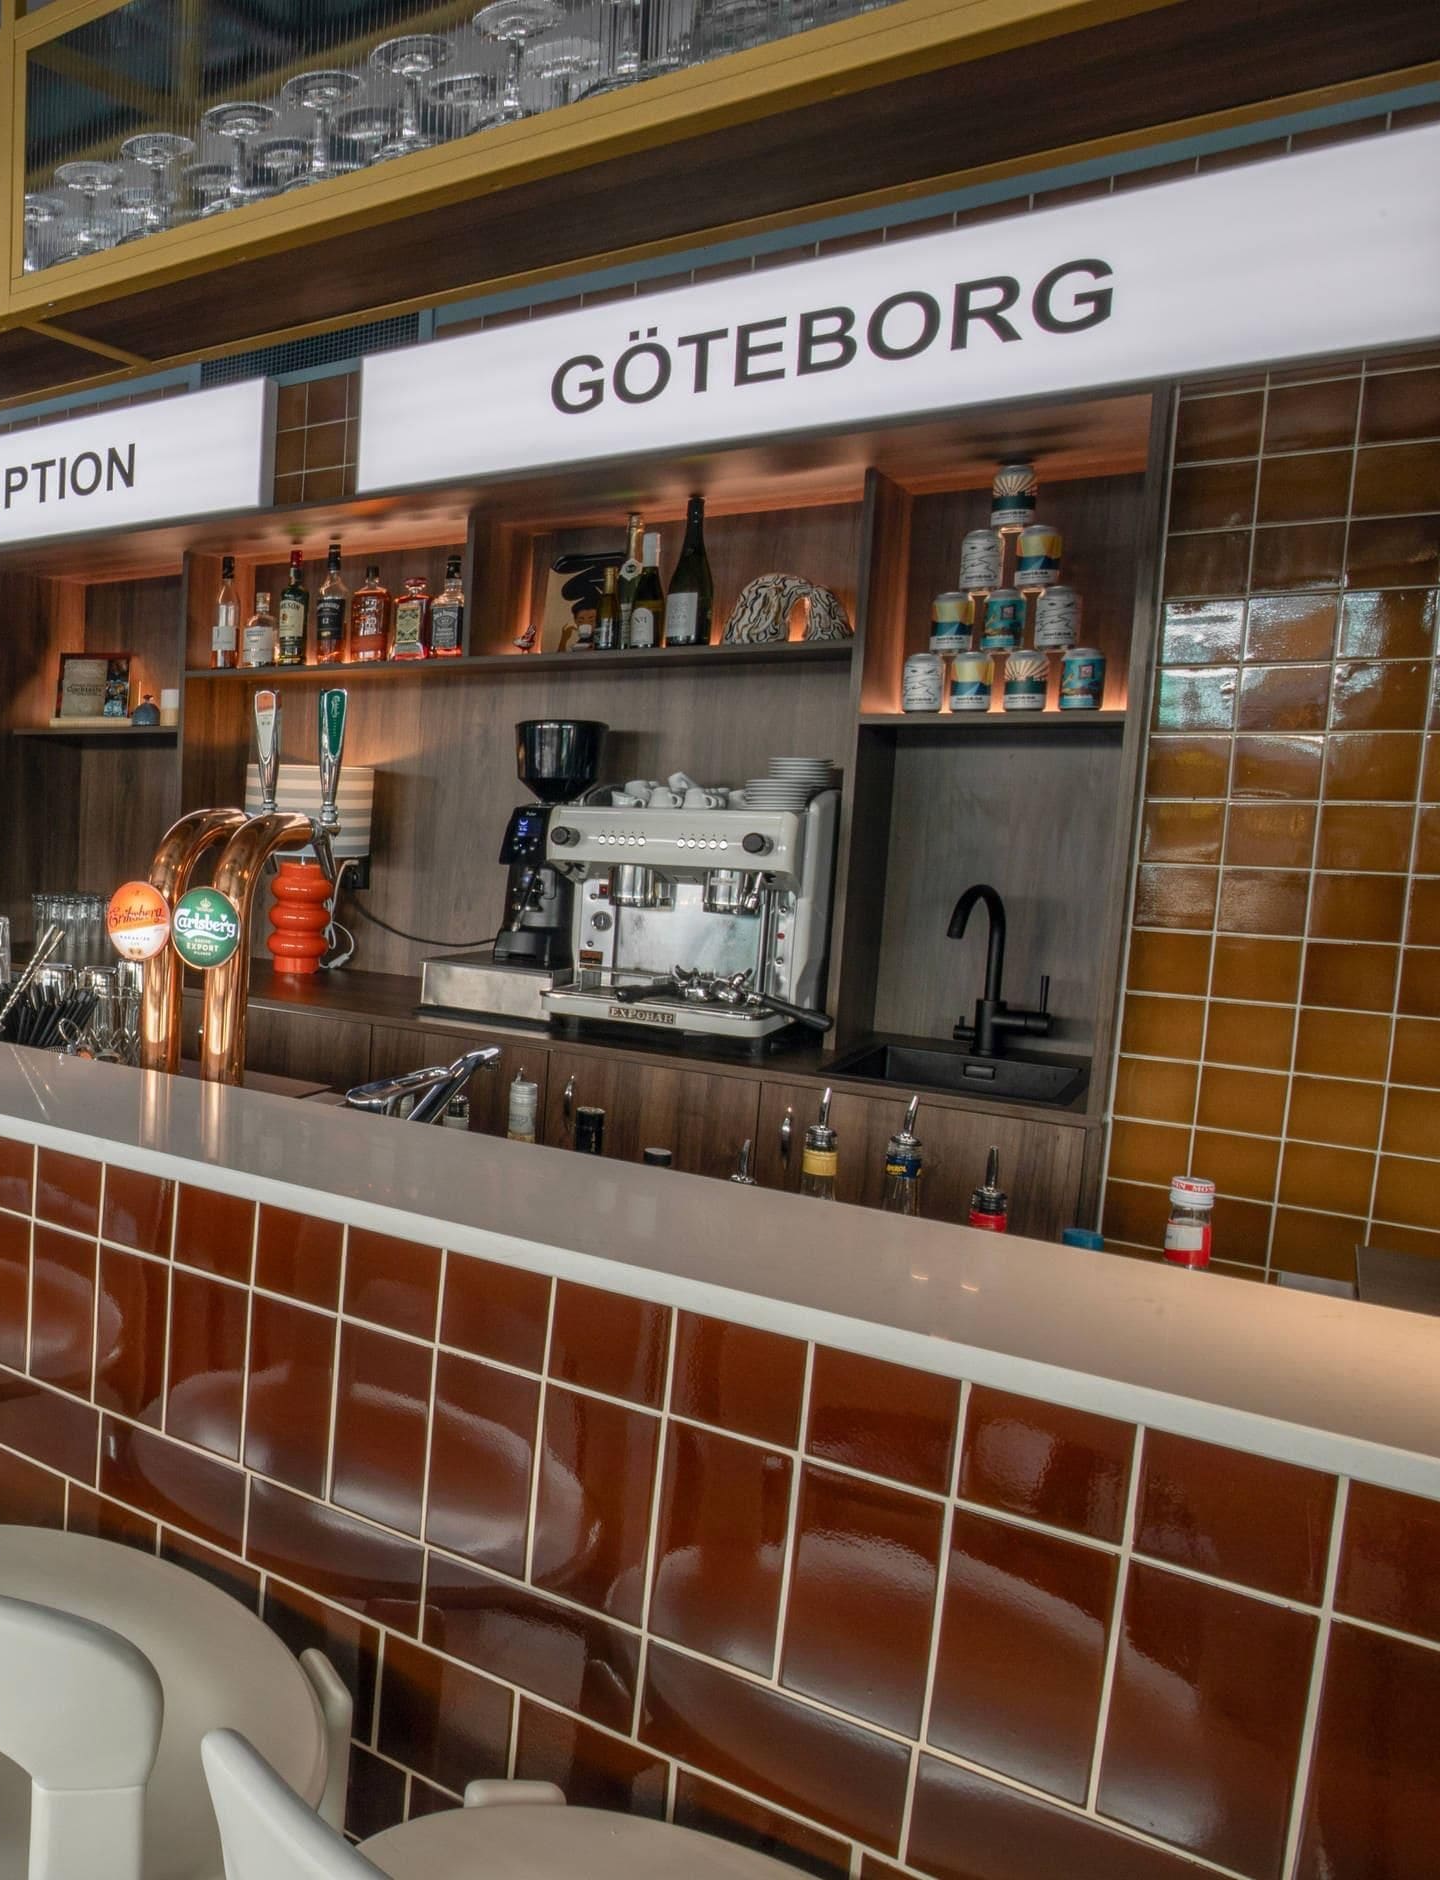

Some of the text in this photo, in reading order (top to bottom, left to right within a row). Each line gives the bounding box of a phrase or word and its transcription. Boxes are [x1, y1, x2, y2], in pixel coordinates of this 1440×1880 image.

[550, 258, 1114, 415] GÖTEBORG
[173, 908, 236, 939] Carlsberg
[186, 942, 219, 953] EXPORT
[610, 1007, 674, 1024] EXPOBAR
